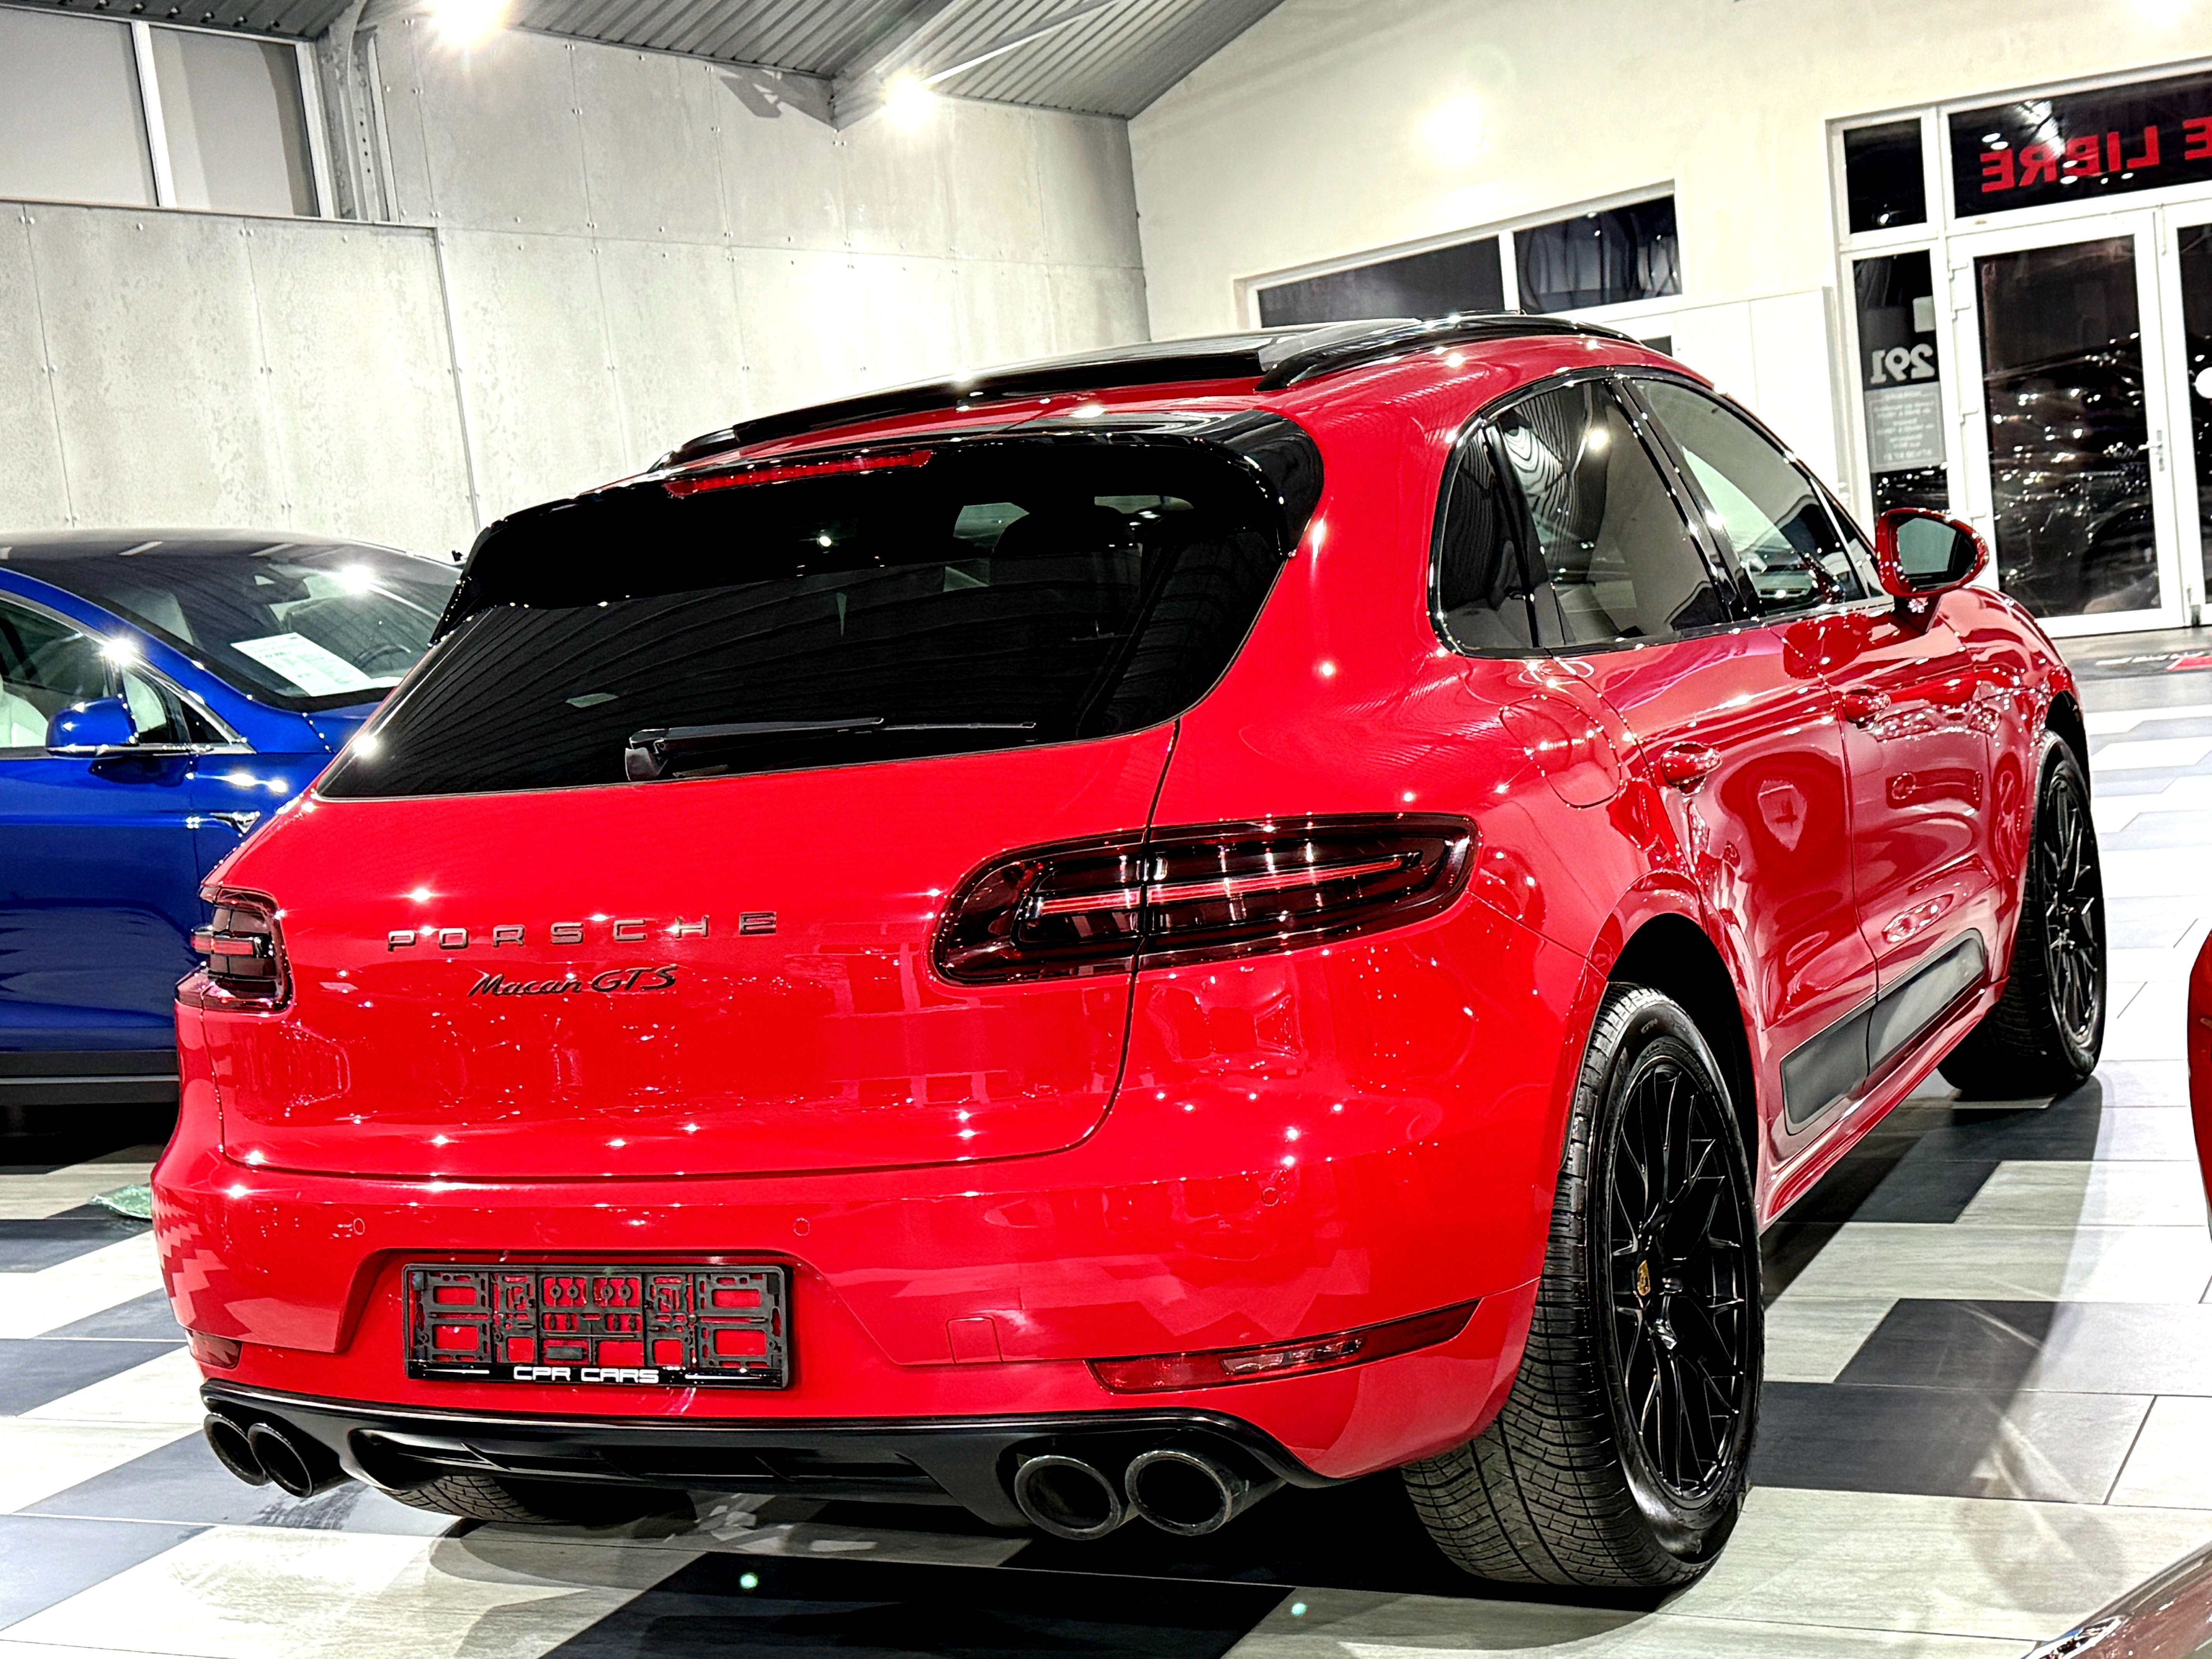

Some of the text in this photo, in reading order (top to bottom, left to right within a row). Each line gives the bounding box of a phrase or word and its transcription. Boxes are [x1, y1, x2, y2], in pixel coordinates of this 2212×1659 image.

[388, 911, 777, 951] PORSCHE
[467, 963, 678, 998] Macan GTS
[514, 1366, 659, 1384] CPR CARS
